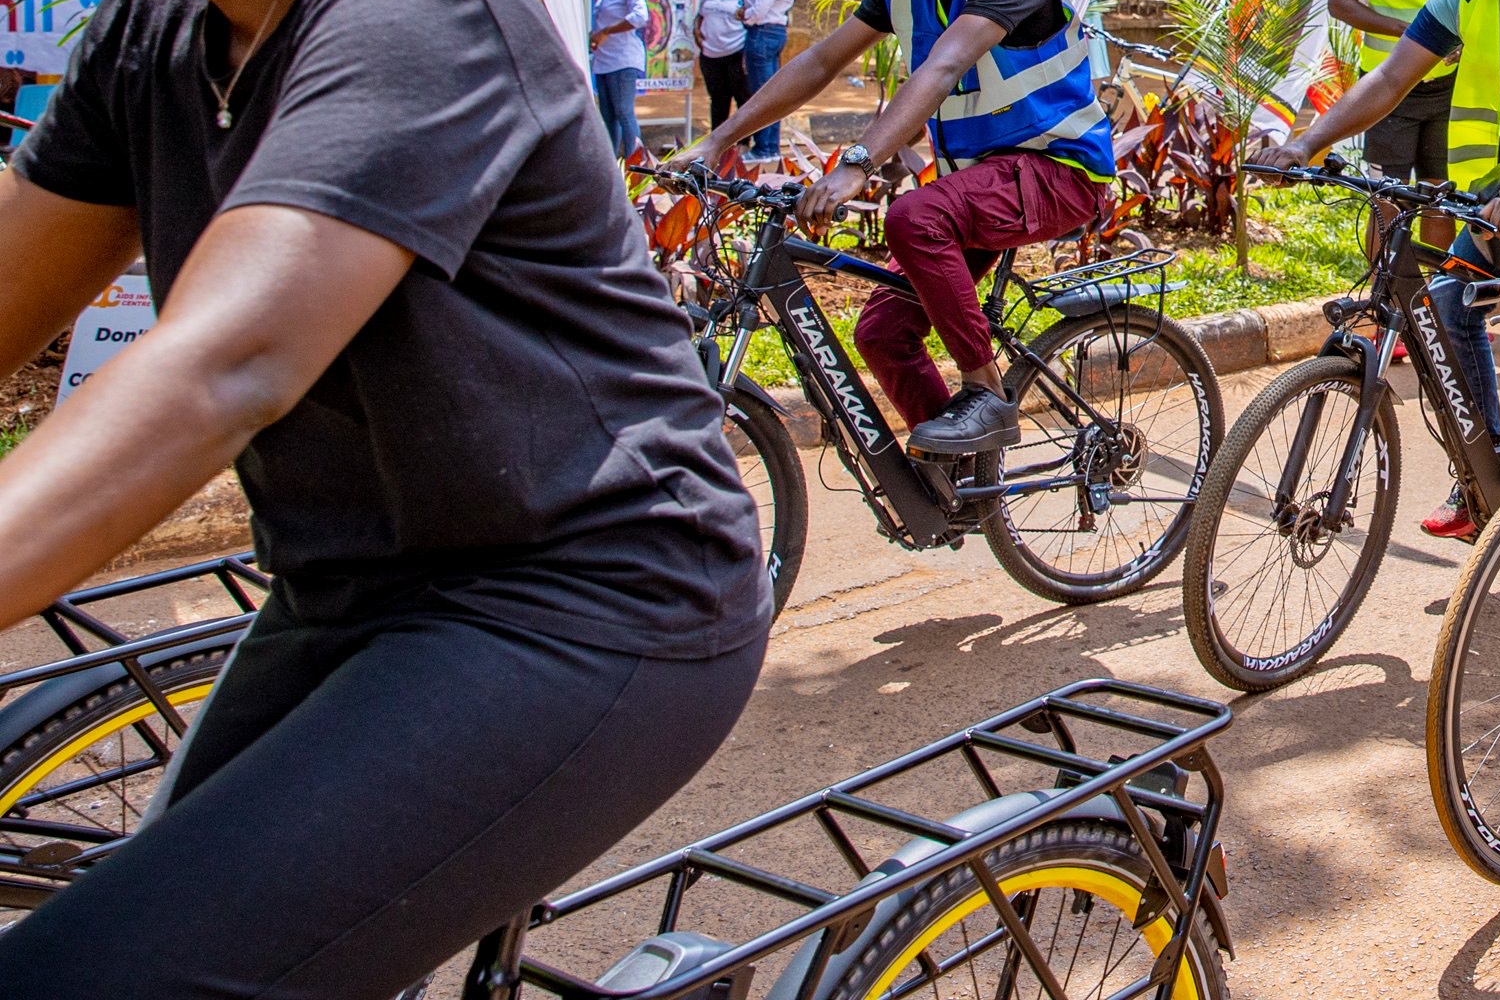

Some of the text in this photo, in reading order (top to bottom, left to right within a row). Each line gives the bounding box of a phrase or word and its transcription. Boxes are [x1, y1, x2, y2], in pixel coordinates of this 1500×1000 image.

[95, 327, 148, 342] Don'
[790, 306, 881, 449] HARAKKA
[1413, 306, 1476, 438] HARAKKA
